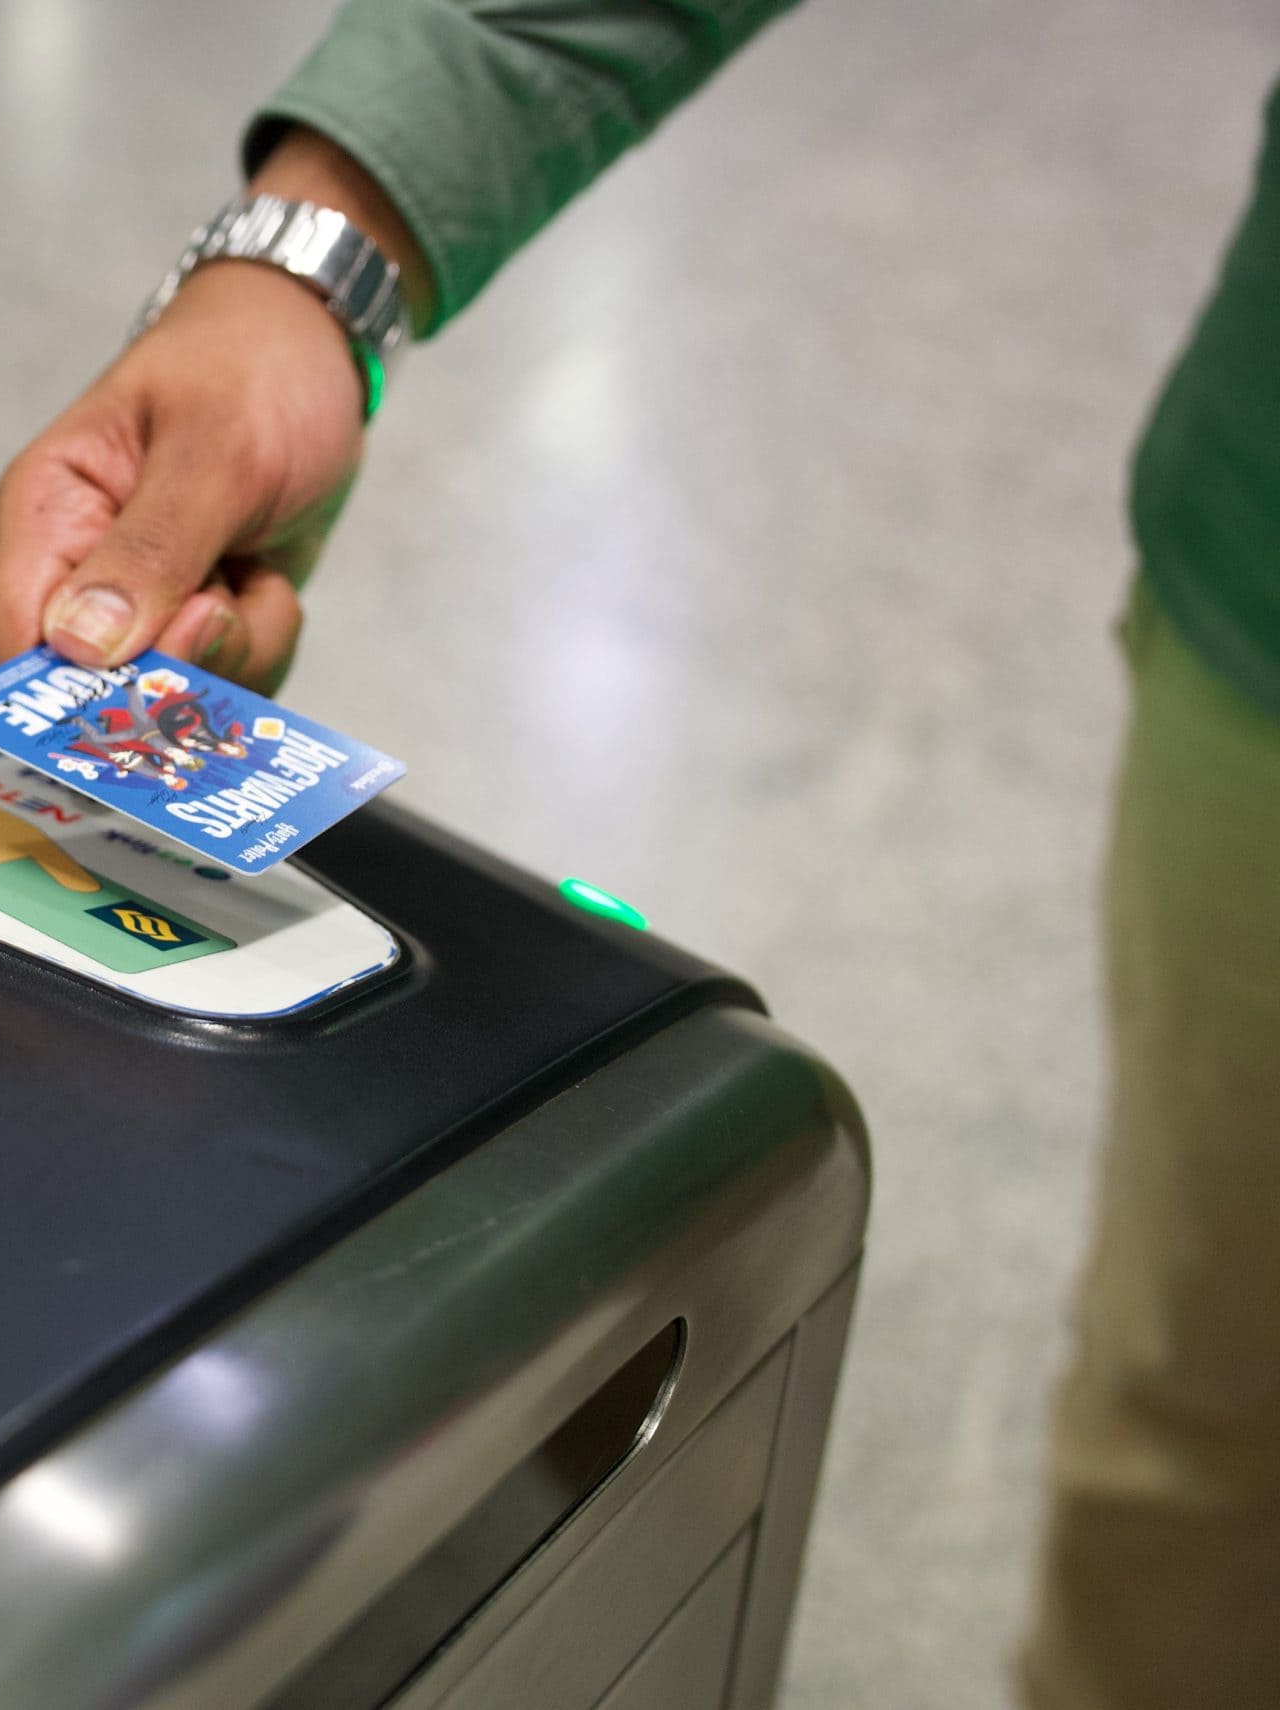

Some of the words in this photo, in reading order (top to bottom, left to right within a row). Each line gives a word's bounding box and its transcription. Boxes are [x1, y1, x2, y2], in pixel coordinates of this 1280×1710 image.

[166, 729, 349, 839] HOGWARTS
[238, 838, 270, 864] Potter
[264, 822, 300, 854] Harry
